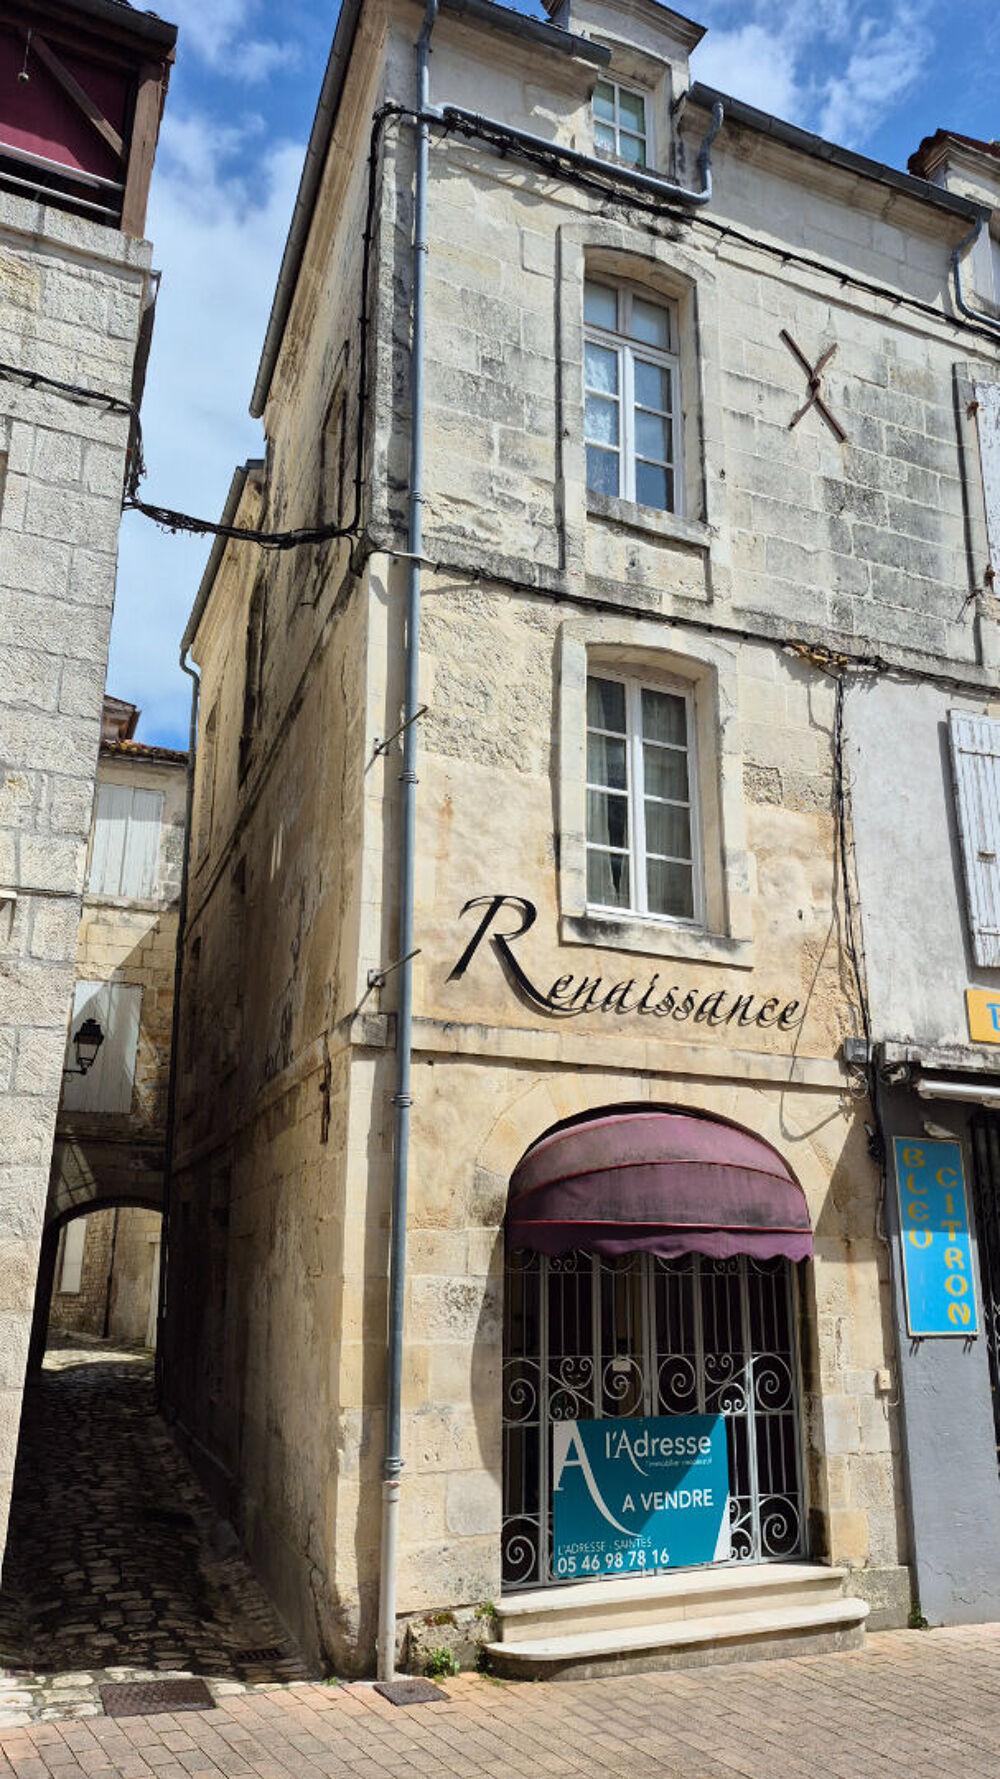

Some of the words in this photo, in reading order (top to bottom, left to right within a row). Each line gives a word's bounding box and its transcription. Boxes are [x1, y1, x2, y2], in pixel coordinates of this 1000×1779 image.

[446, 895, 801, 1028] Renaissance
[902, 1147, 933, 1249] BLEU
[936, 1167, 970, 1325] CITRON
[606, 1430, 712, 1476] l'Adresse
[622, 1493, 635, 1513] A
[641, 1489, 714, 1511] VENDRE
[557, 1541, 605, 1556] L'ADRESSE
[614, 1536, 652, 1550] SAINTES
[557, 1556, 577, 1574] 05
[581, 1555, 600, 1571] 46
[605, 1552, 624, 1569] 98
[627, 1549, 646, 1567] 78
[652, 1547, 670, 1564] 16
